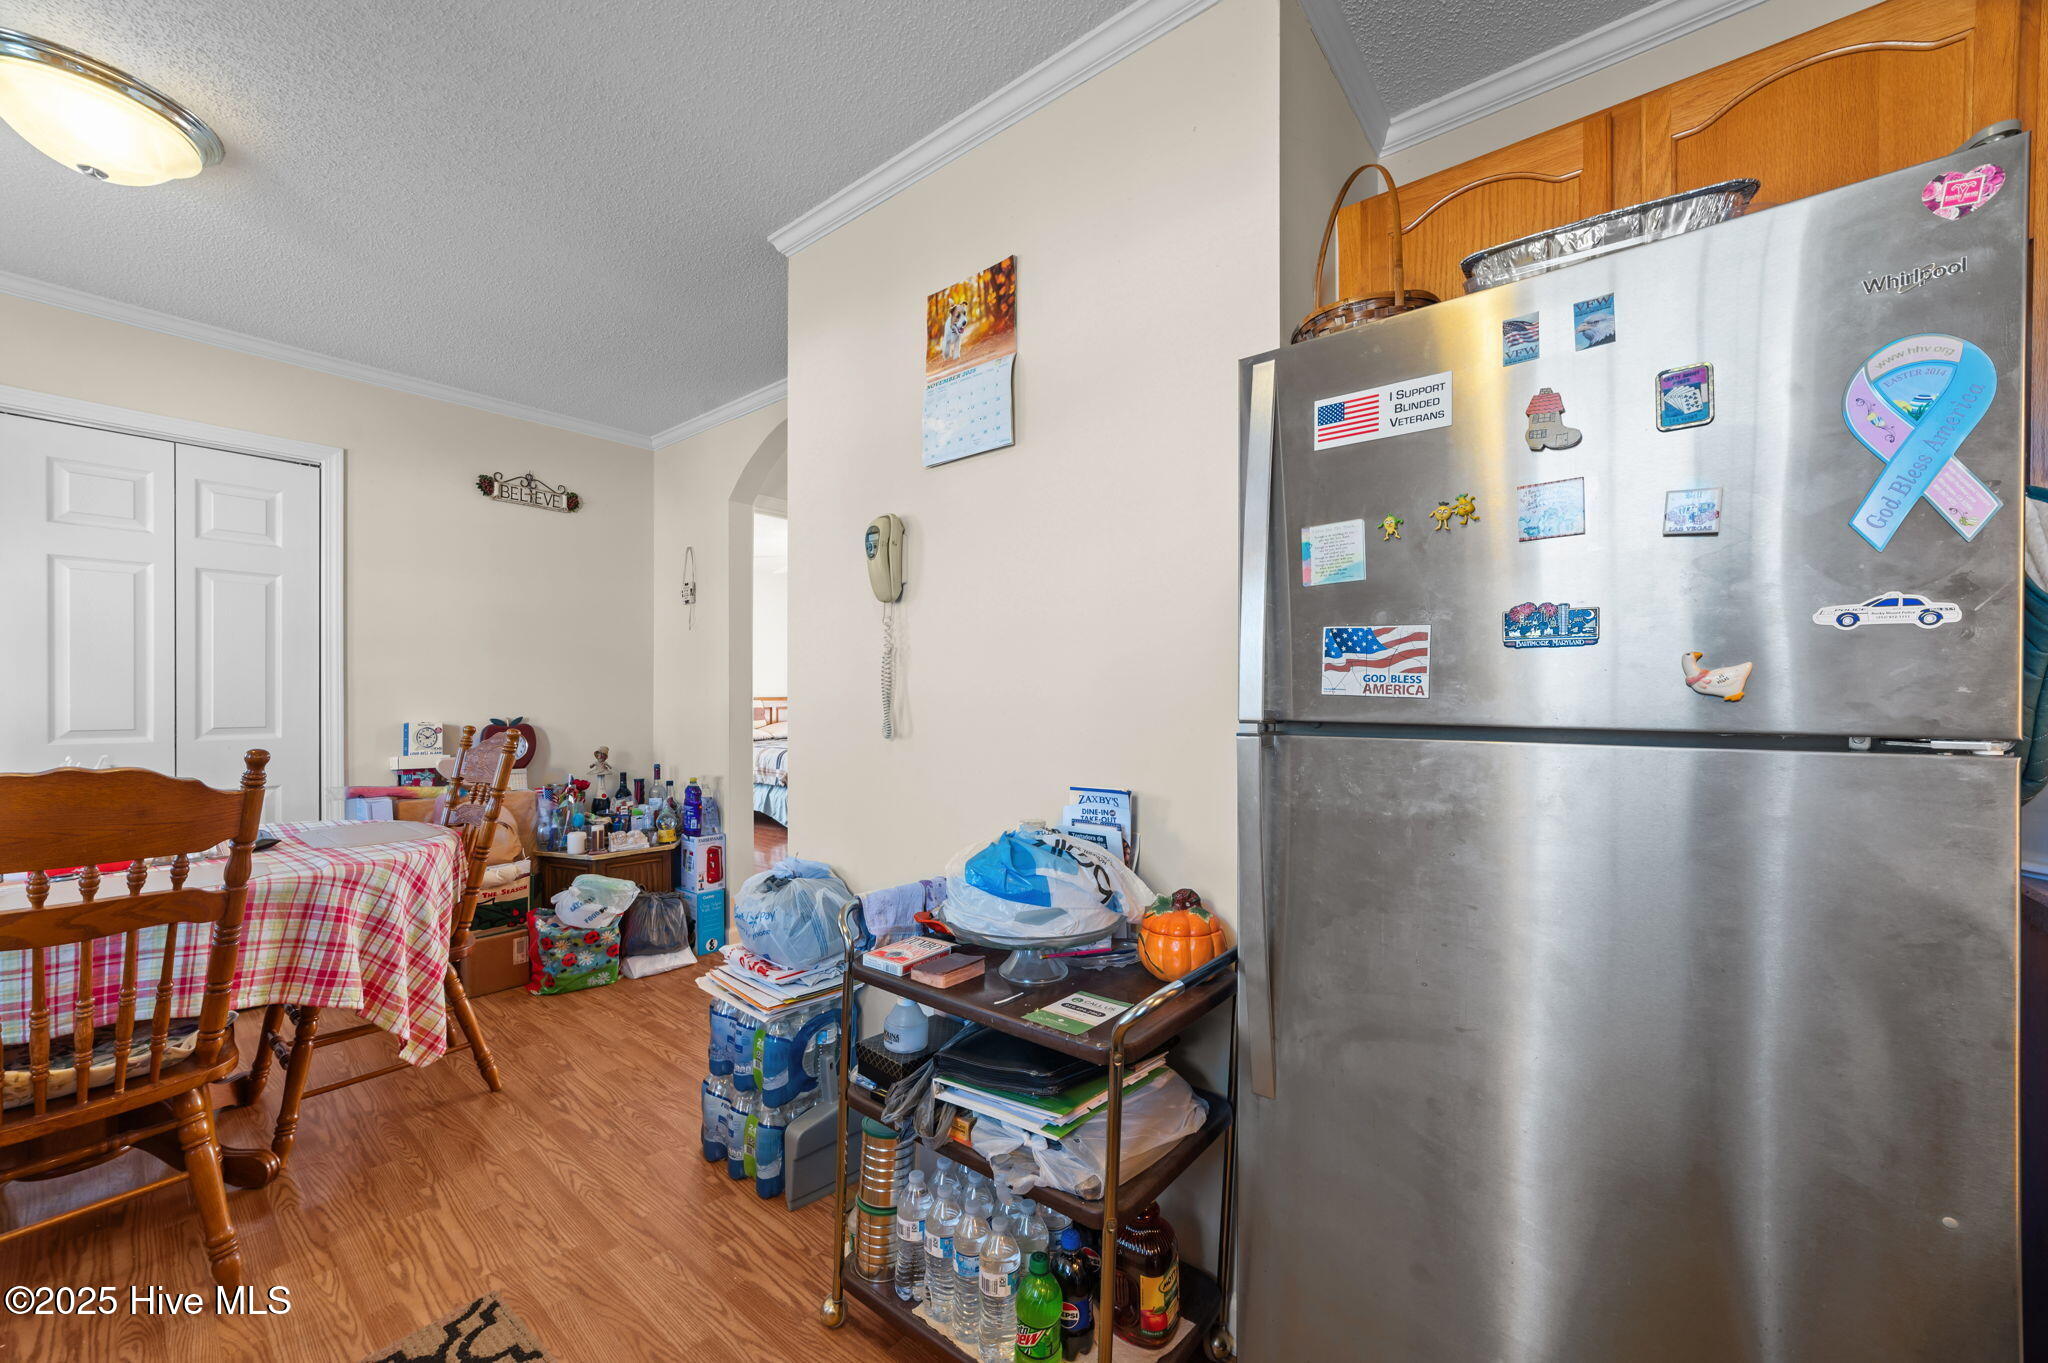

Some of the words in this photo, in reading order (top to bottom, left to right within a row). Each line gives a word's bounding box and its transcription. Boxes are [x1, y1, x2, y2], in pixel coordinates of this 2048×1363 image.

[1861, 256, 1968, 294] Whirlpool
[1575, 295, 1611, 312] VFW
[1505, 345, 1538, 359] VFW
[1875, 343, 1956, 371] www.hhv.org
[926, 375, 961, 390] NOVEMBER
[962, 367, 977, 379] 2025
[1883, 367, 1922, 389] EASTER
[1924, 367, 1948, 378] 2014
[1396, 382, 1446, 400] SUPPORT
[1394, 397, 1440, 414] BLINDED
[1389, 410, 1445, 428] VETERANS
[1866, 496, 1899, 529] God
[1888, 454, 1933, 495] Bless
[1923, 383, 1985, 453] America
[500, 484, 561, 509] BELIEVE
[1363, 674, 1386, 683] GOD
[1391, 674, 1422, 684] BLESS
[1362, 683, 1425, 696] AMERICA
[1078, 795, 1119, 808] ZAXBY'S
[1082, 808, 1109, 816] DINE-IN
[482, 891, 497, 899] THE
[501, 885, 528, 896] SEASON
